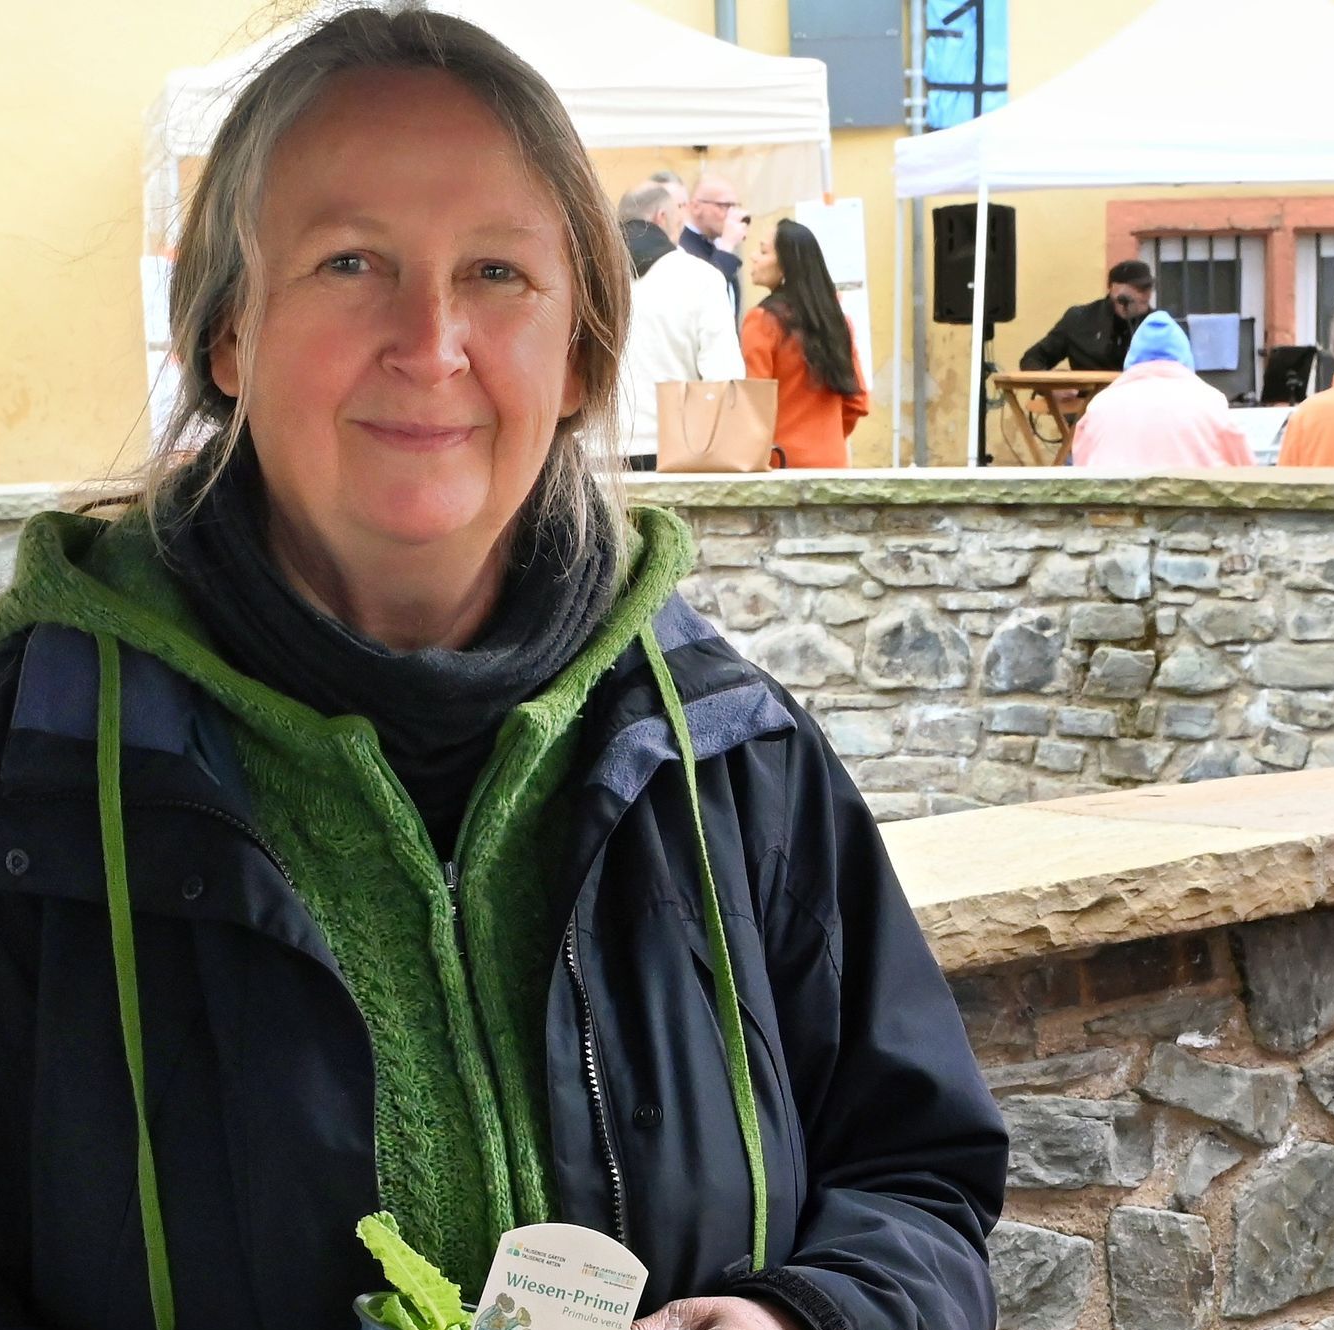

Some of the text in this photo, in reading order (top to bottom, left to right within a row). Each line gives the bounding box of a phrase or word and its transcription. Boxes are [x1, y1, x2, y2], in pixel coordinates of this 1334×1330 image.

[506, 1271, 630, 1316] Wiesen-Primel
[562, 1306, 623, 1330] Primula veris
